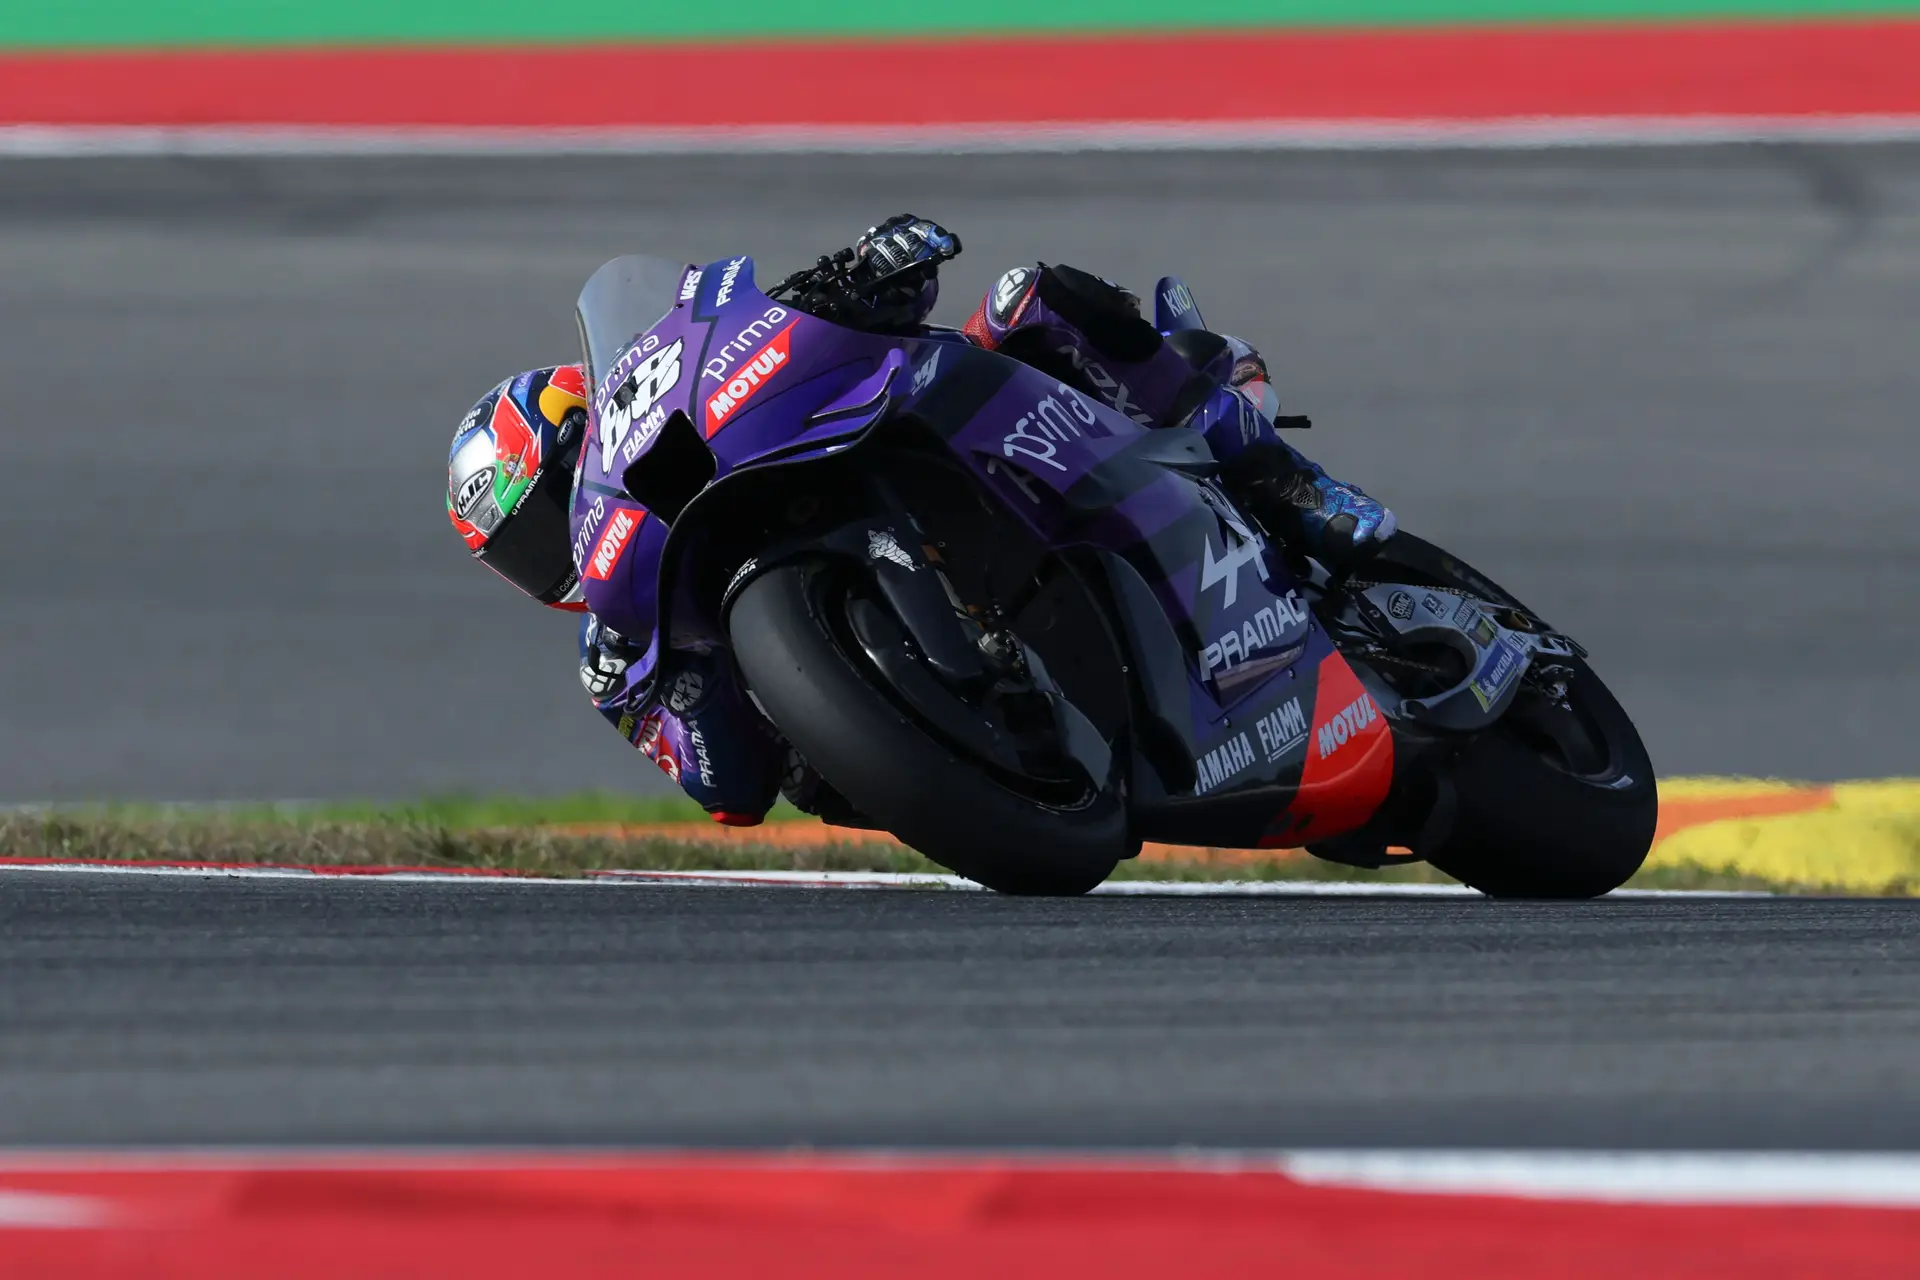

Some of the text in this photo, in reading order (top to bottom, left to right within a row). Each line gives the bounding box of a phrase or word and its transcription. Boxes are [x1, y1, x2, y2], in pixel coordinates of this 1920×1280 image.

[680, 270, 703, 300] WRS
[594, 335, 660, 415] prima
[702, 307, 787, 382] prima
[600, 336, 684, 474] 88
[709, 347, 786, 420] MOTUL
[622, 405, 665, 462] FIAMM
[1003, 384, 1096, 471] prima
[458, 469, 492, 515] HJC
[516, 467, 544, 509] PRAMAC
[573, 497, 605, 575] prima
[594, 511, 633, 579] MOTUL
[1198, 588, 1307, 682] PRAMAC
[1393, 593, 1411, 615] BMC
[688, 719, 717, 788] PRAMA
[1256, 697, 1307, 755] FIAMM
[1318, 693, 1376, 760] MOTUL
